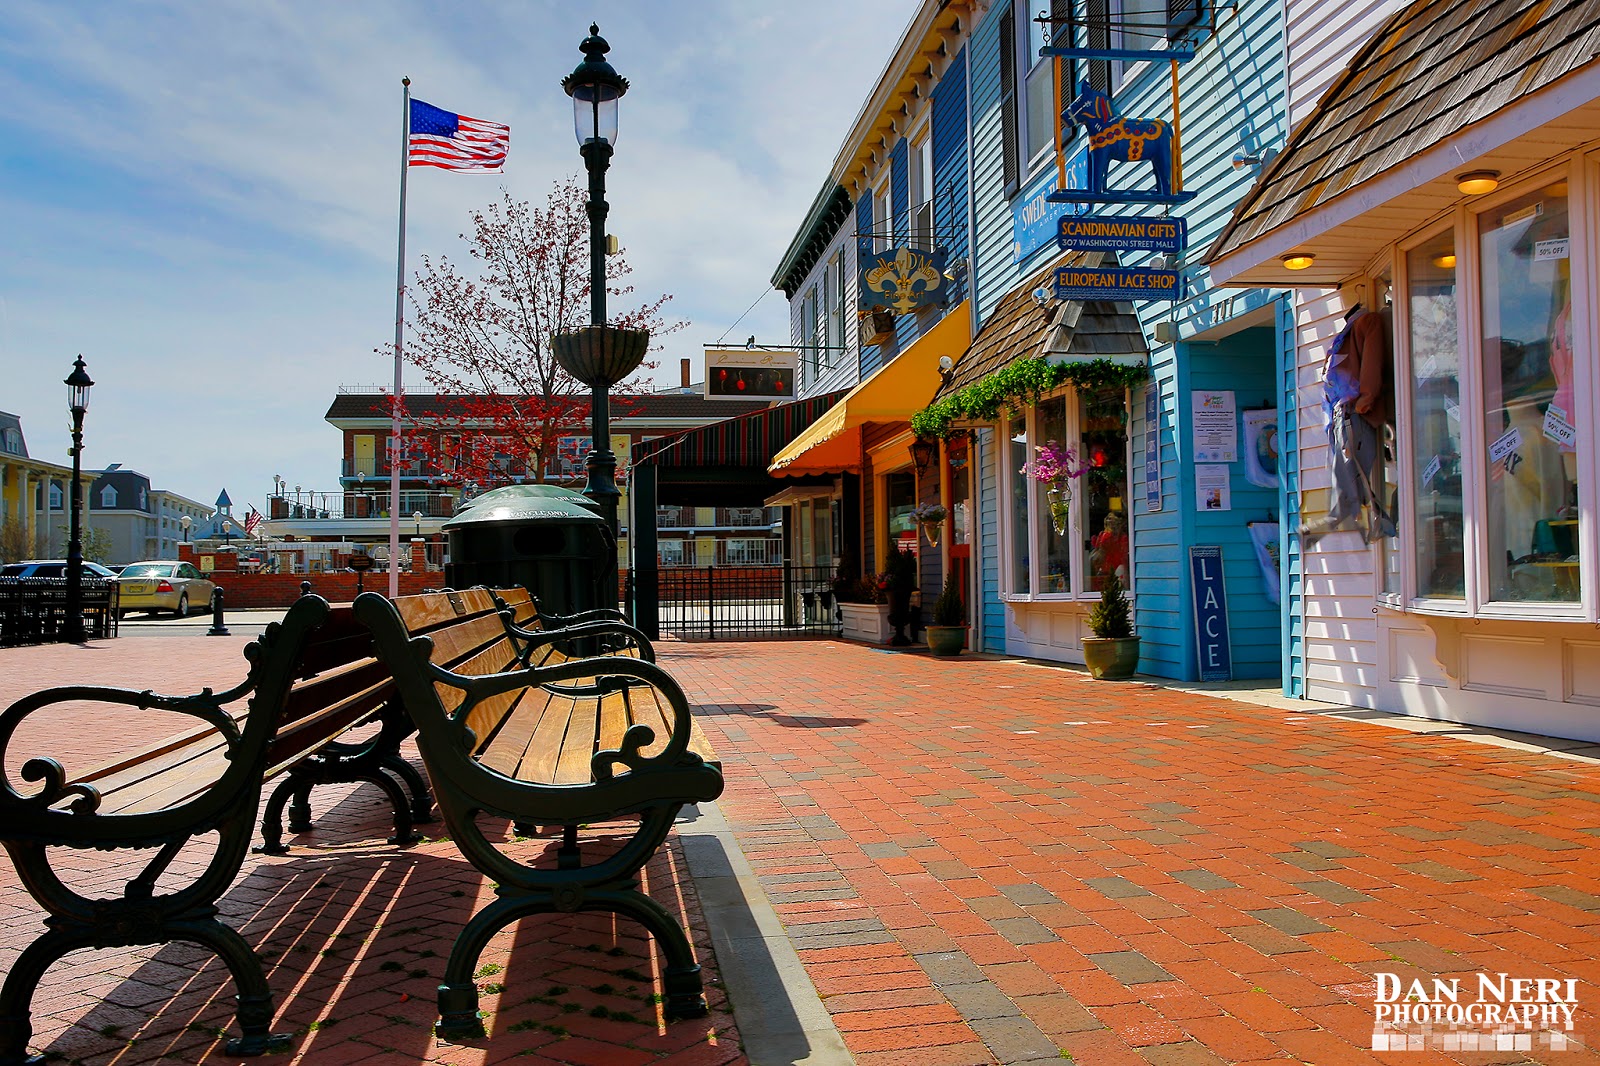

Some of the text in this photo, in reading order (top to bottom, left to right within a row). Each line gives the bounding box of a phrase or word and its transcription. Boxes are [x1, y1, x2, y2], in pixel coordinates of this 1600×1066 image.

[1022, 190, 1047, 231] SWEDE
[1061, 221, 1176, 239] SCANDINAVIAN GIFTS
[1062, 238, 1175, 249] 307 WASHINGTON STREET MALL
[1539, 246, 1564, 256] 50% OFF
[864, 257, 905, 285] Gallery
[1059, 272, 1176, 289] EUROPEAN LACE SHOP
[884, 290, 925, 299] Fine Art
[1548, 421, 1571, 439] 50% OFF
[1494, 437, 1517, 456] 50% OFF
[1200, 558, 1221, 668] LACE
